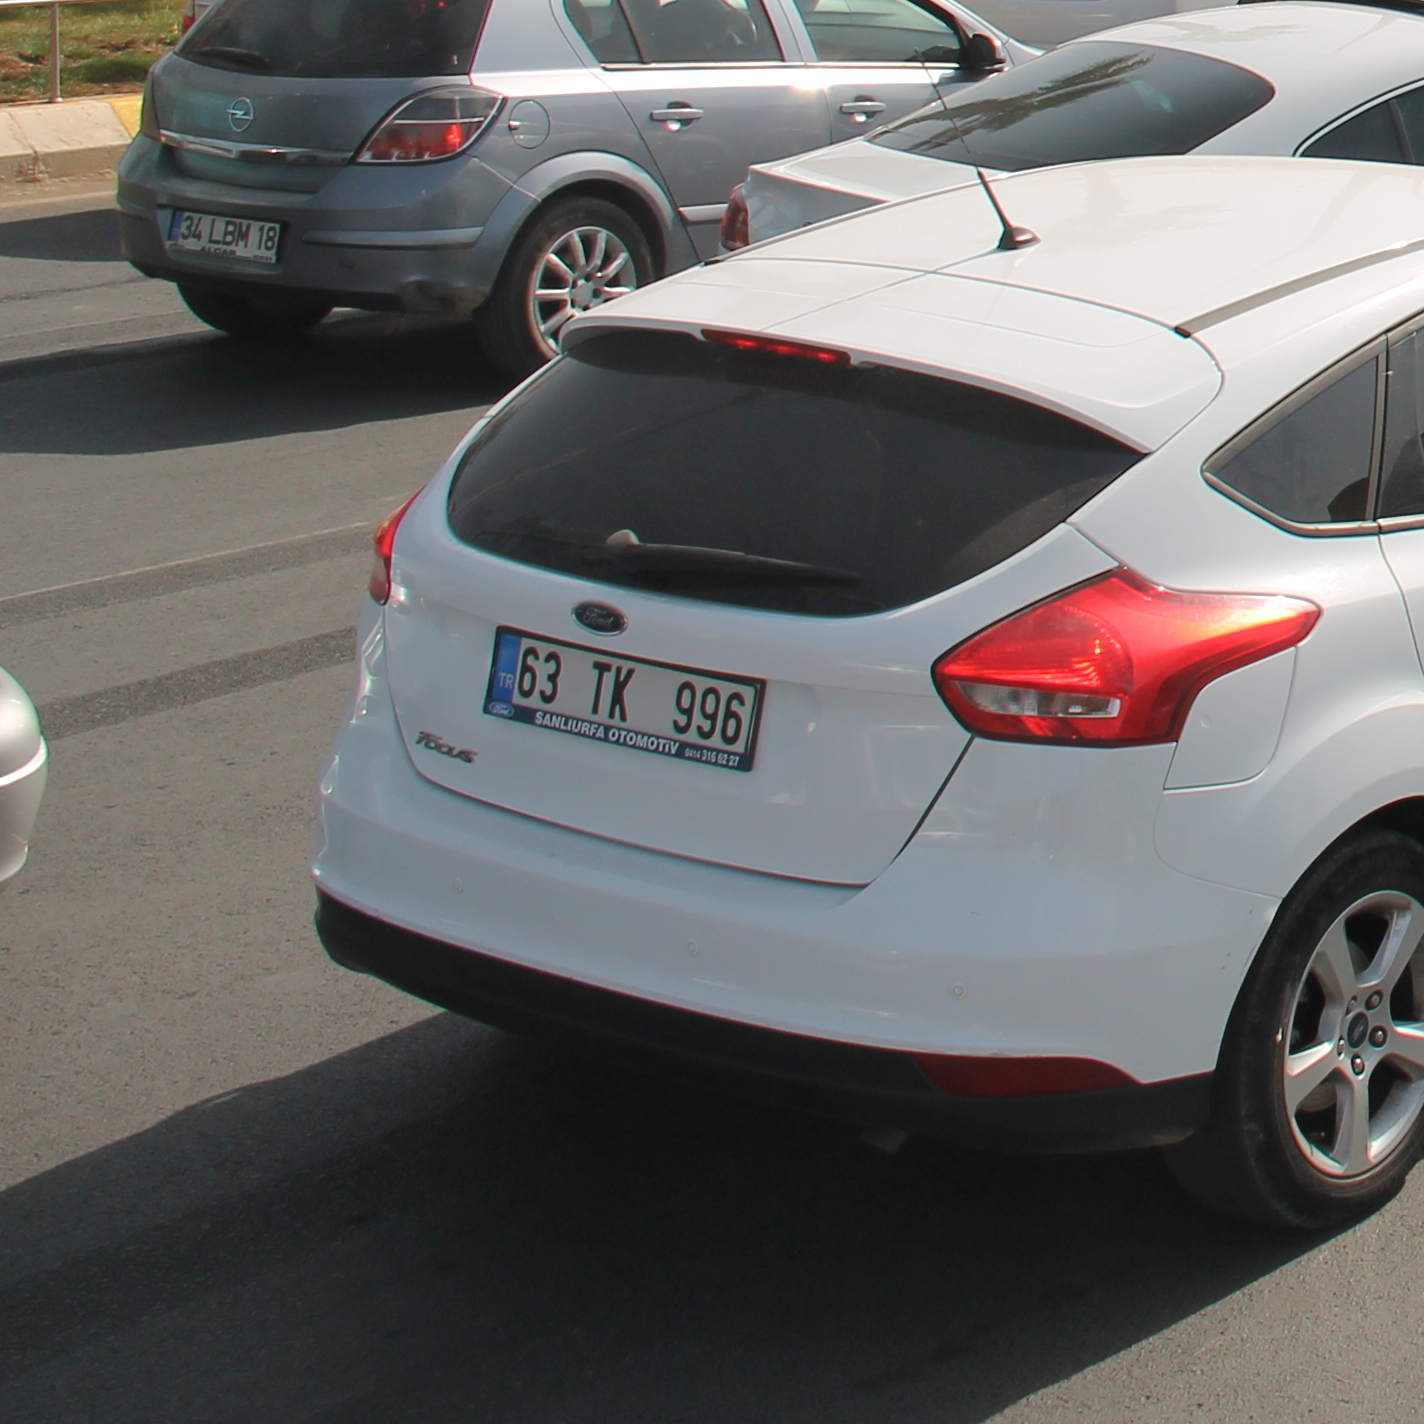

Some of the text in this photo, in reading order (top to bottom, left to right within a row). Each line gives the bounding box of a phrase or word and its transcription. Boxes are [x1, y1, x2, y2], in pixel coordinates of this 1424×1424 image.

[181, 215, 278, 252] 34 LBM 18
[498, 672, 514, 688] TR
[517, 646, 747, 747] 63 TK 996
